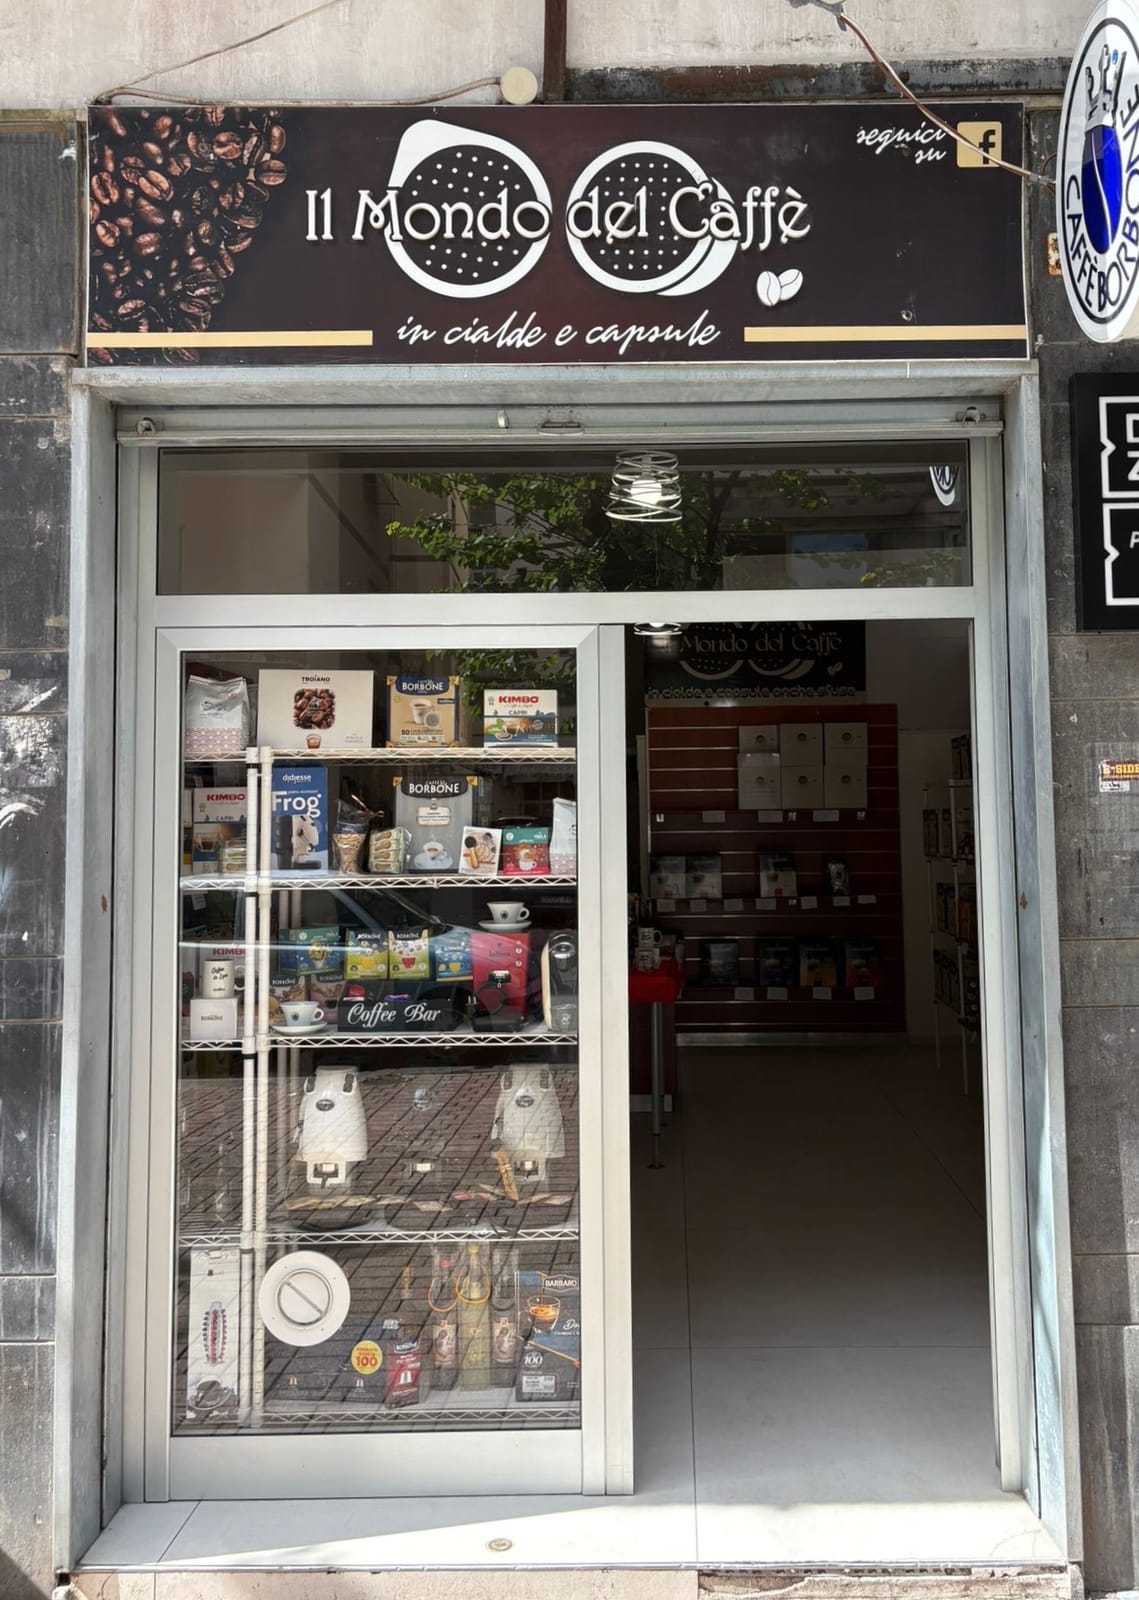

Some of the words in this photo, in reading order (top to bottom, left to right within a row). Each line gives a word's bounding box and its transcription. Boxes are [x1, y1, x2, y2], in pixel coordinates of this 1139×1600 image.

[856, 121, 947, 155] seguici
[915, 148, 947, 164] su
[305, 189, 334, 241] Il
[351, 187, 552, 242] Mondo
[567, 186, 649, 245] del
[668, 181, 811, 251] Caffè
[396, 314, 436, 345] in
[443, 309, 546, 348] cialde
[554, 329, 578, 347] e
[584, 309, 721, 355] capsule
[681, 632, 748, 653] Mondo
[755, 632, 784, 653] del
[401, 681, 444, 691] BORBONE
[498, 695, 539, 704] KIMBO
[408, 783, 460, 794] BORBONE
[206, 793, 246, 801] KIMBO
[271, 790, 322, 818] Frog
[212, 948, 246, 956] KIMB
[347, 1001, 397, 1028] Coffee
[403, 1002, 441, 1023] Bar
[545, 1279, 578, 1287] BARBARO
[355, 1356, 378, 1367] 100
